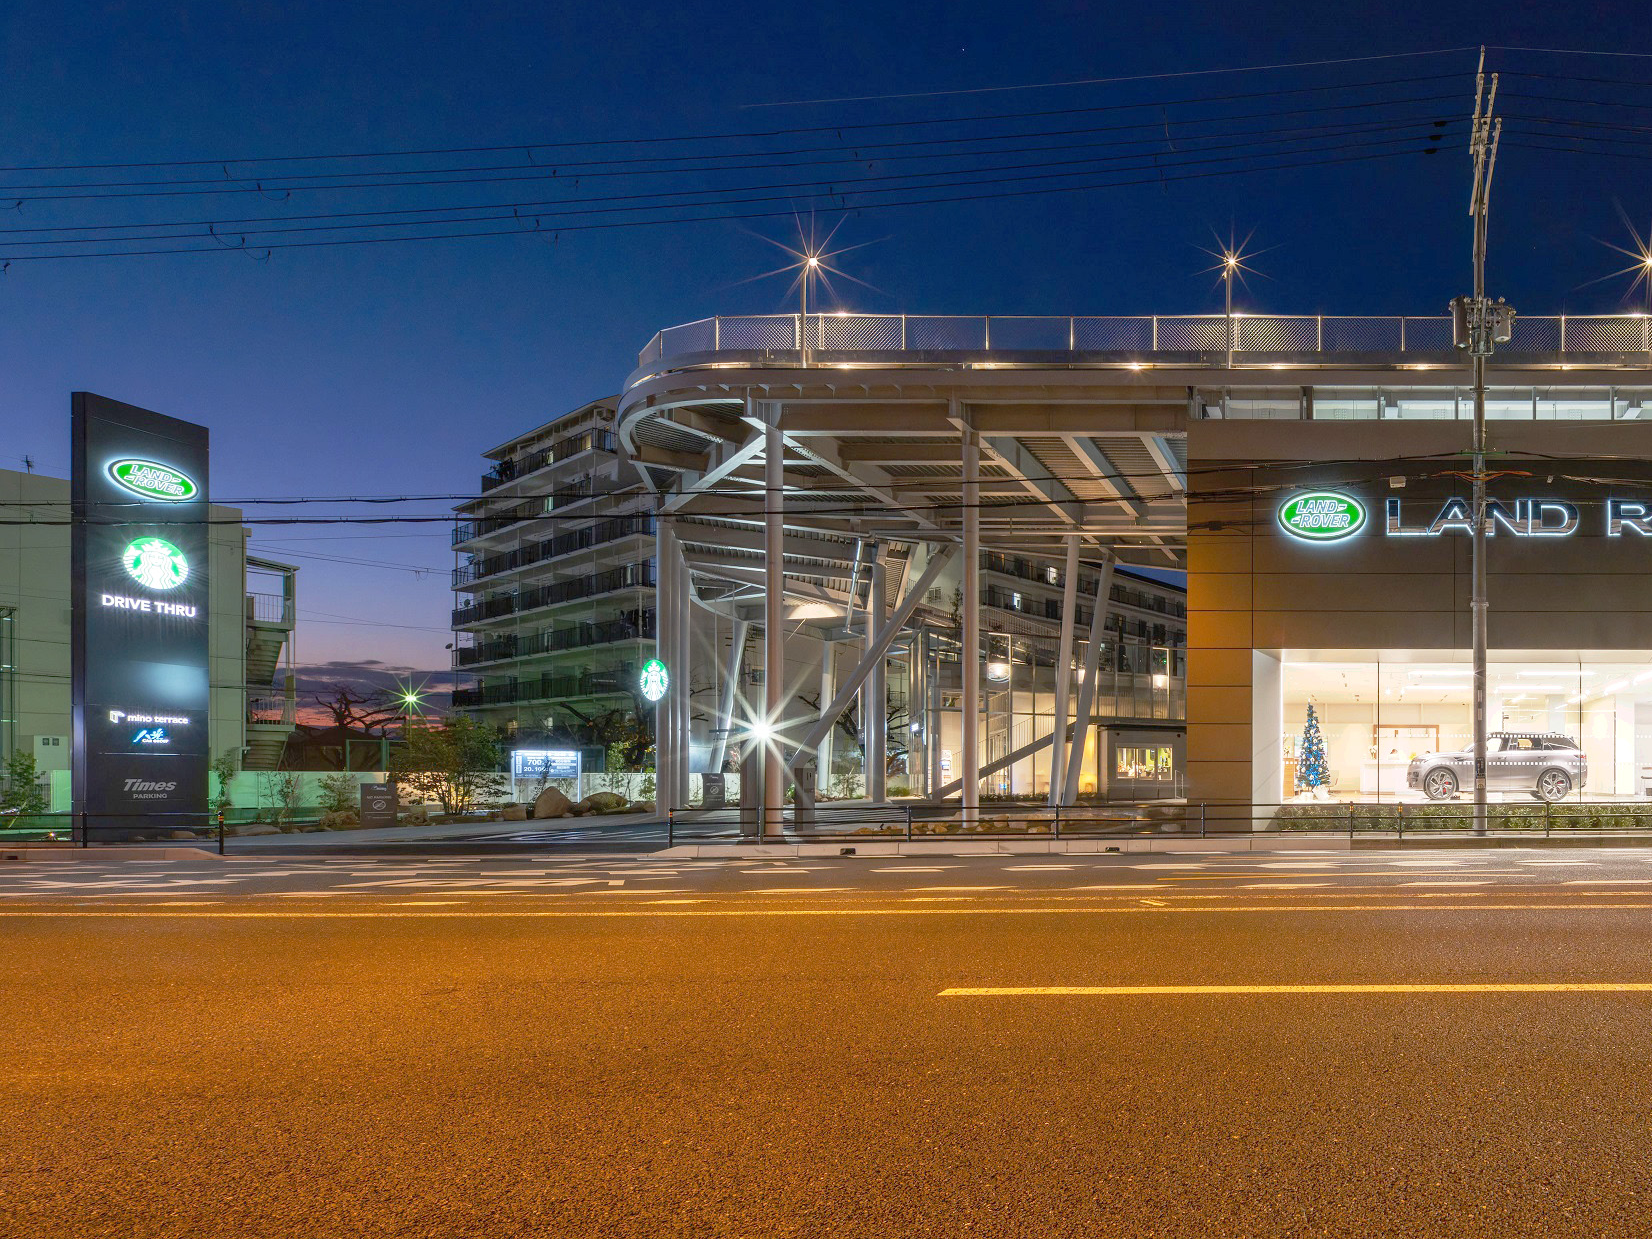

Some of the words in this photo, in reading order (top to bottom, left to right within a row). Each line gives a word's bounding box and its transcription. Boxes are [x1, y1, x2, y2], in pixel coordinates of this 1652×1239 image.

[130, 465, 172, 482] LAND
[133, 476, 184, 495] ROVER
[1296, 500, 1339, 514] LAND
[1300, 514, 1350, 528] ROVER
[1385, 497, 1579, 537] LAND
[102, 594, 150, 612] DRIVE
[153, 601, 196, 618] THRU
[127, 714, 152, 723] mino
[154, 715, 189, 724] terrace
[123, 778, 177, 792] Times
